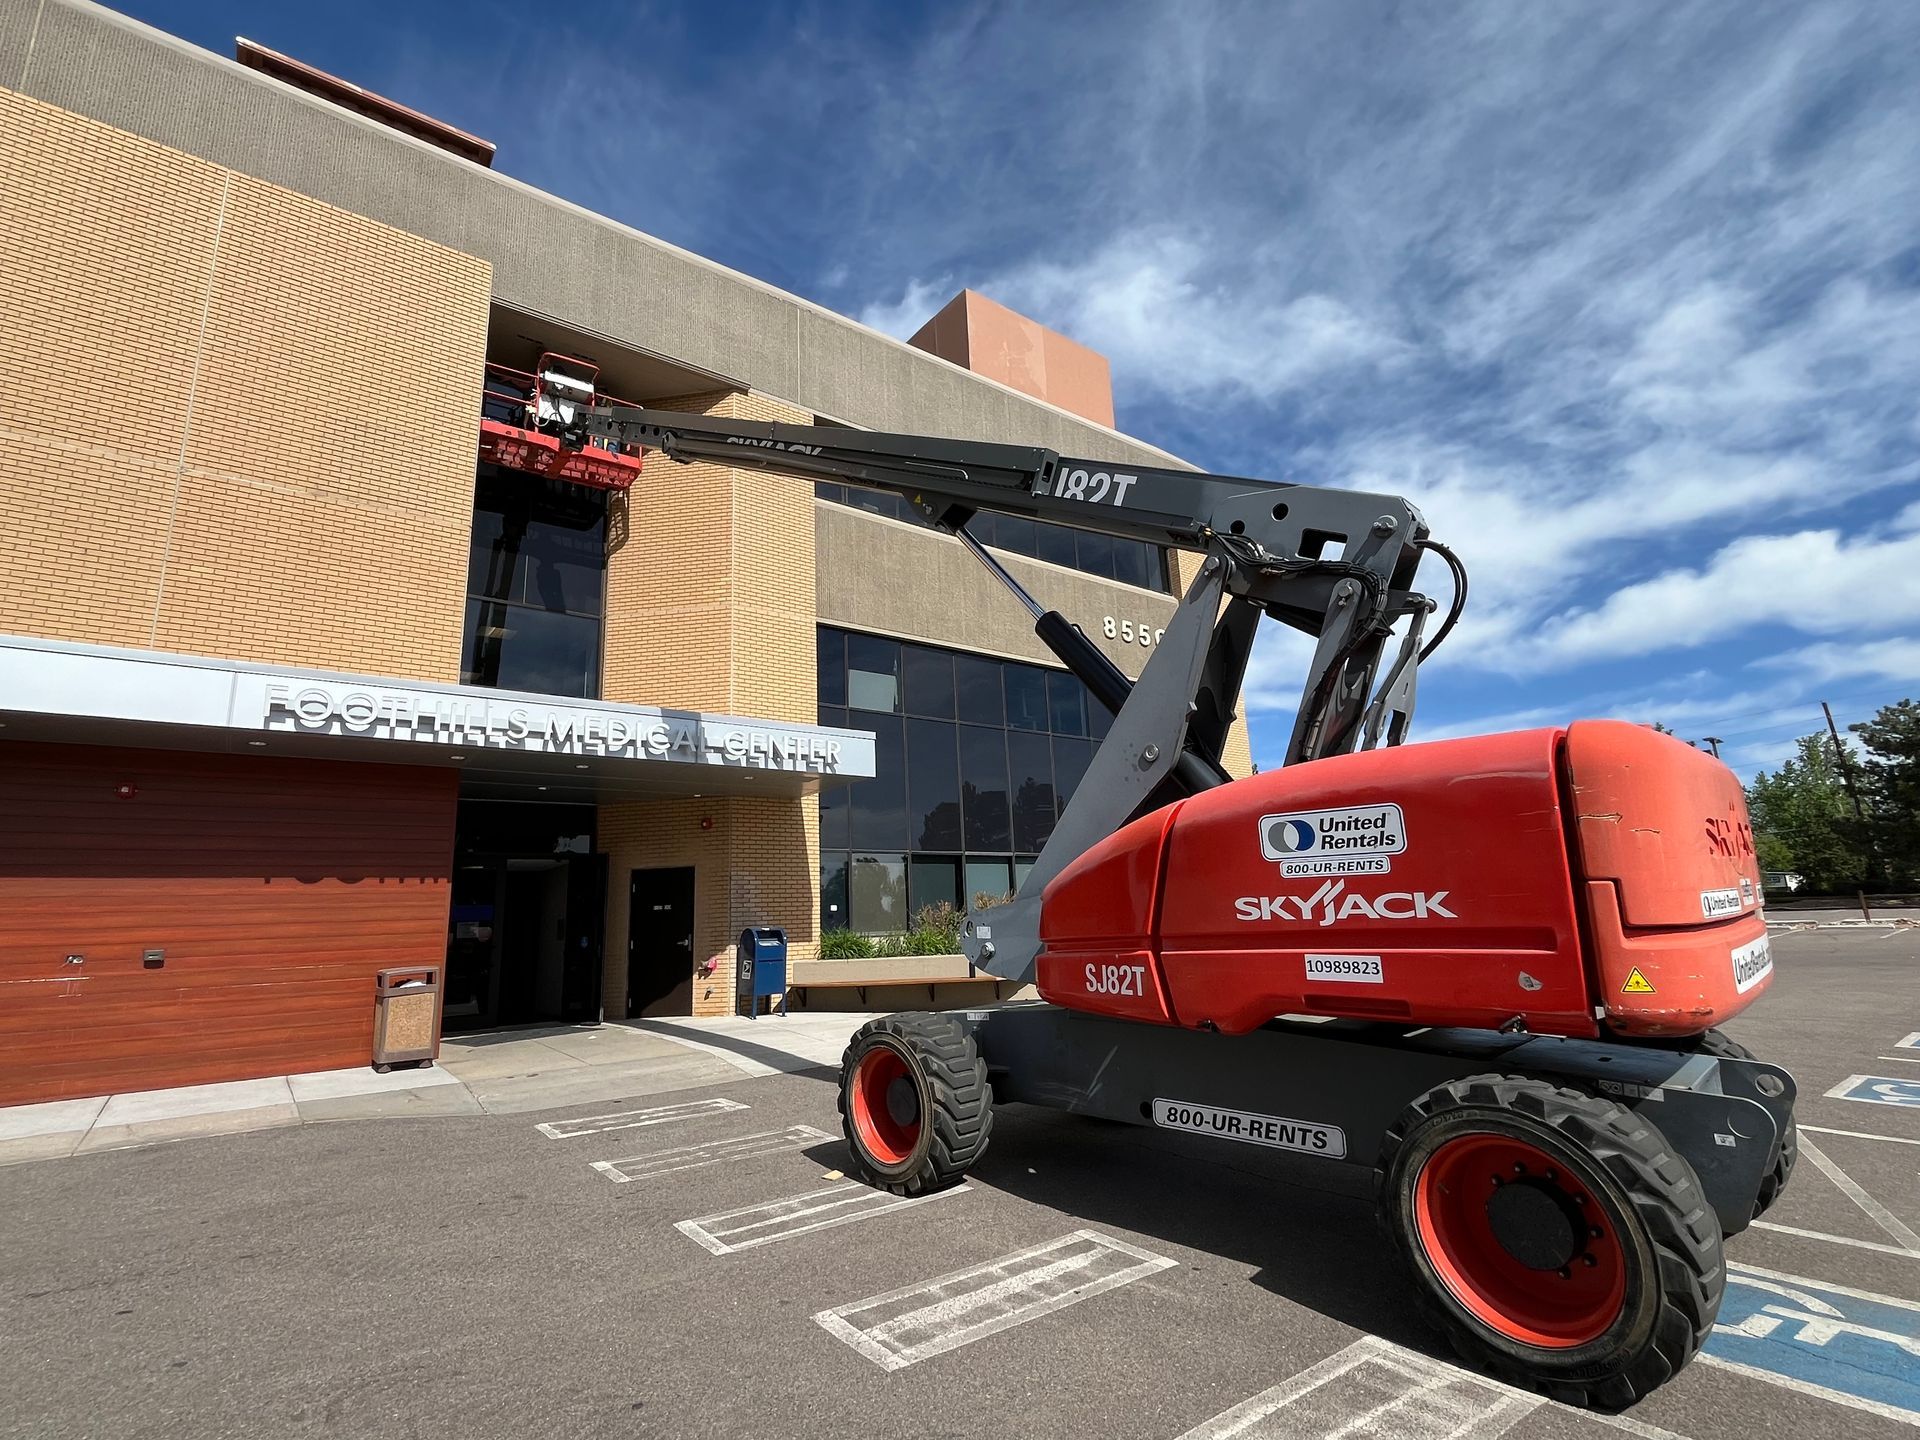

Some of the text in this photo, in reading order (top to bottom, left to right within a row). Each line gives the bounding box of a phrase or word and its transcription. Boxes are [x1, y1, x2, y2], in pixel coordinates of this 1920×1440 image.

[264, 684, 842, 765] FOOTHILLS MEDICAL CENTER
[1319, 813, 1387, 833] United
[1321, 831, 1396, 850] Rentals
[1286, 859, 1384, 874] 800-UR-RENTS
[1234, 878, 1459, 927] SKYJACK
[1085, 963, 1145, 997] SJ82T
[1306, 959, 1381, 976] 10989823
[1166, 1106, 1328, 1150] 800-UR-RENTS
